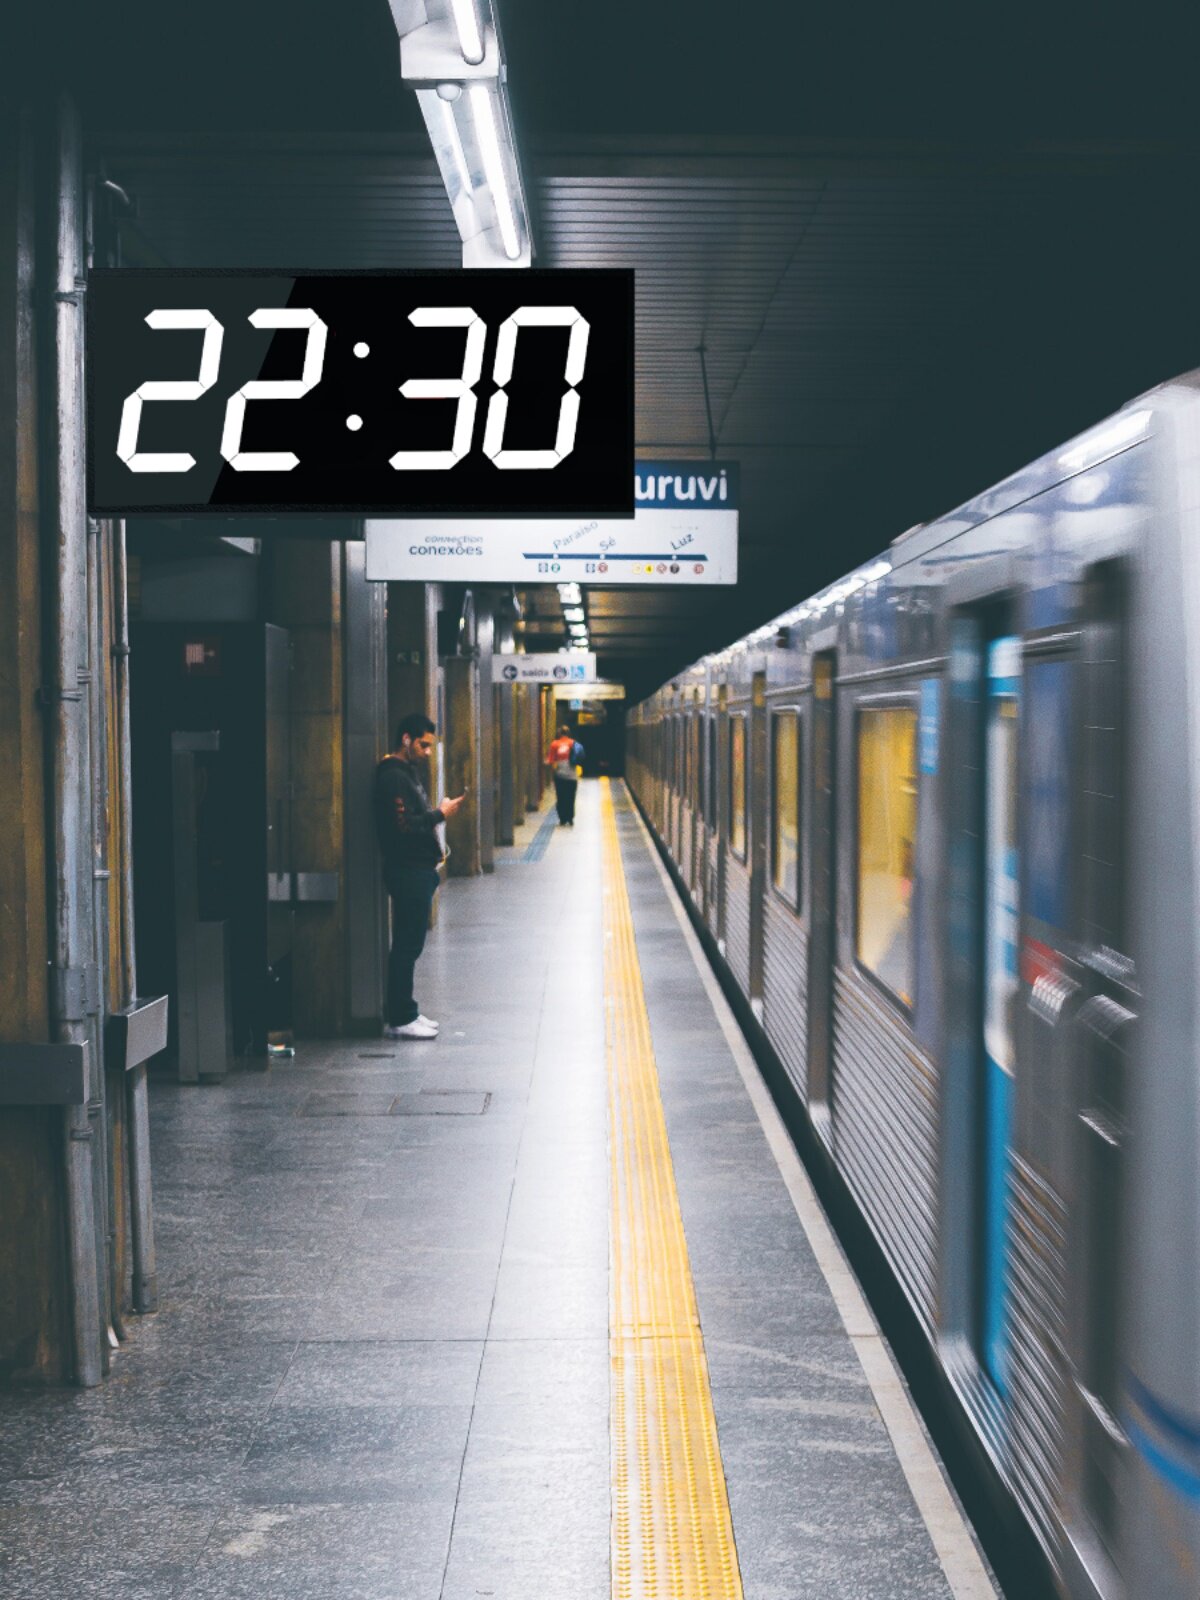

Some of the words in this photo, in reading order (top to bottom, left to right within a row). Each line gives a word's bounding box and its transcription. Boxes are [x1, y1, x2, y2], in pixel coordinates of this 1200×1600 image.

[116, 305, 590, 472] 22:30
[635, 469, 727, 501] uruvi
[669, 533, 695, 550] Luz
